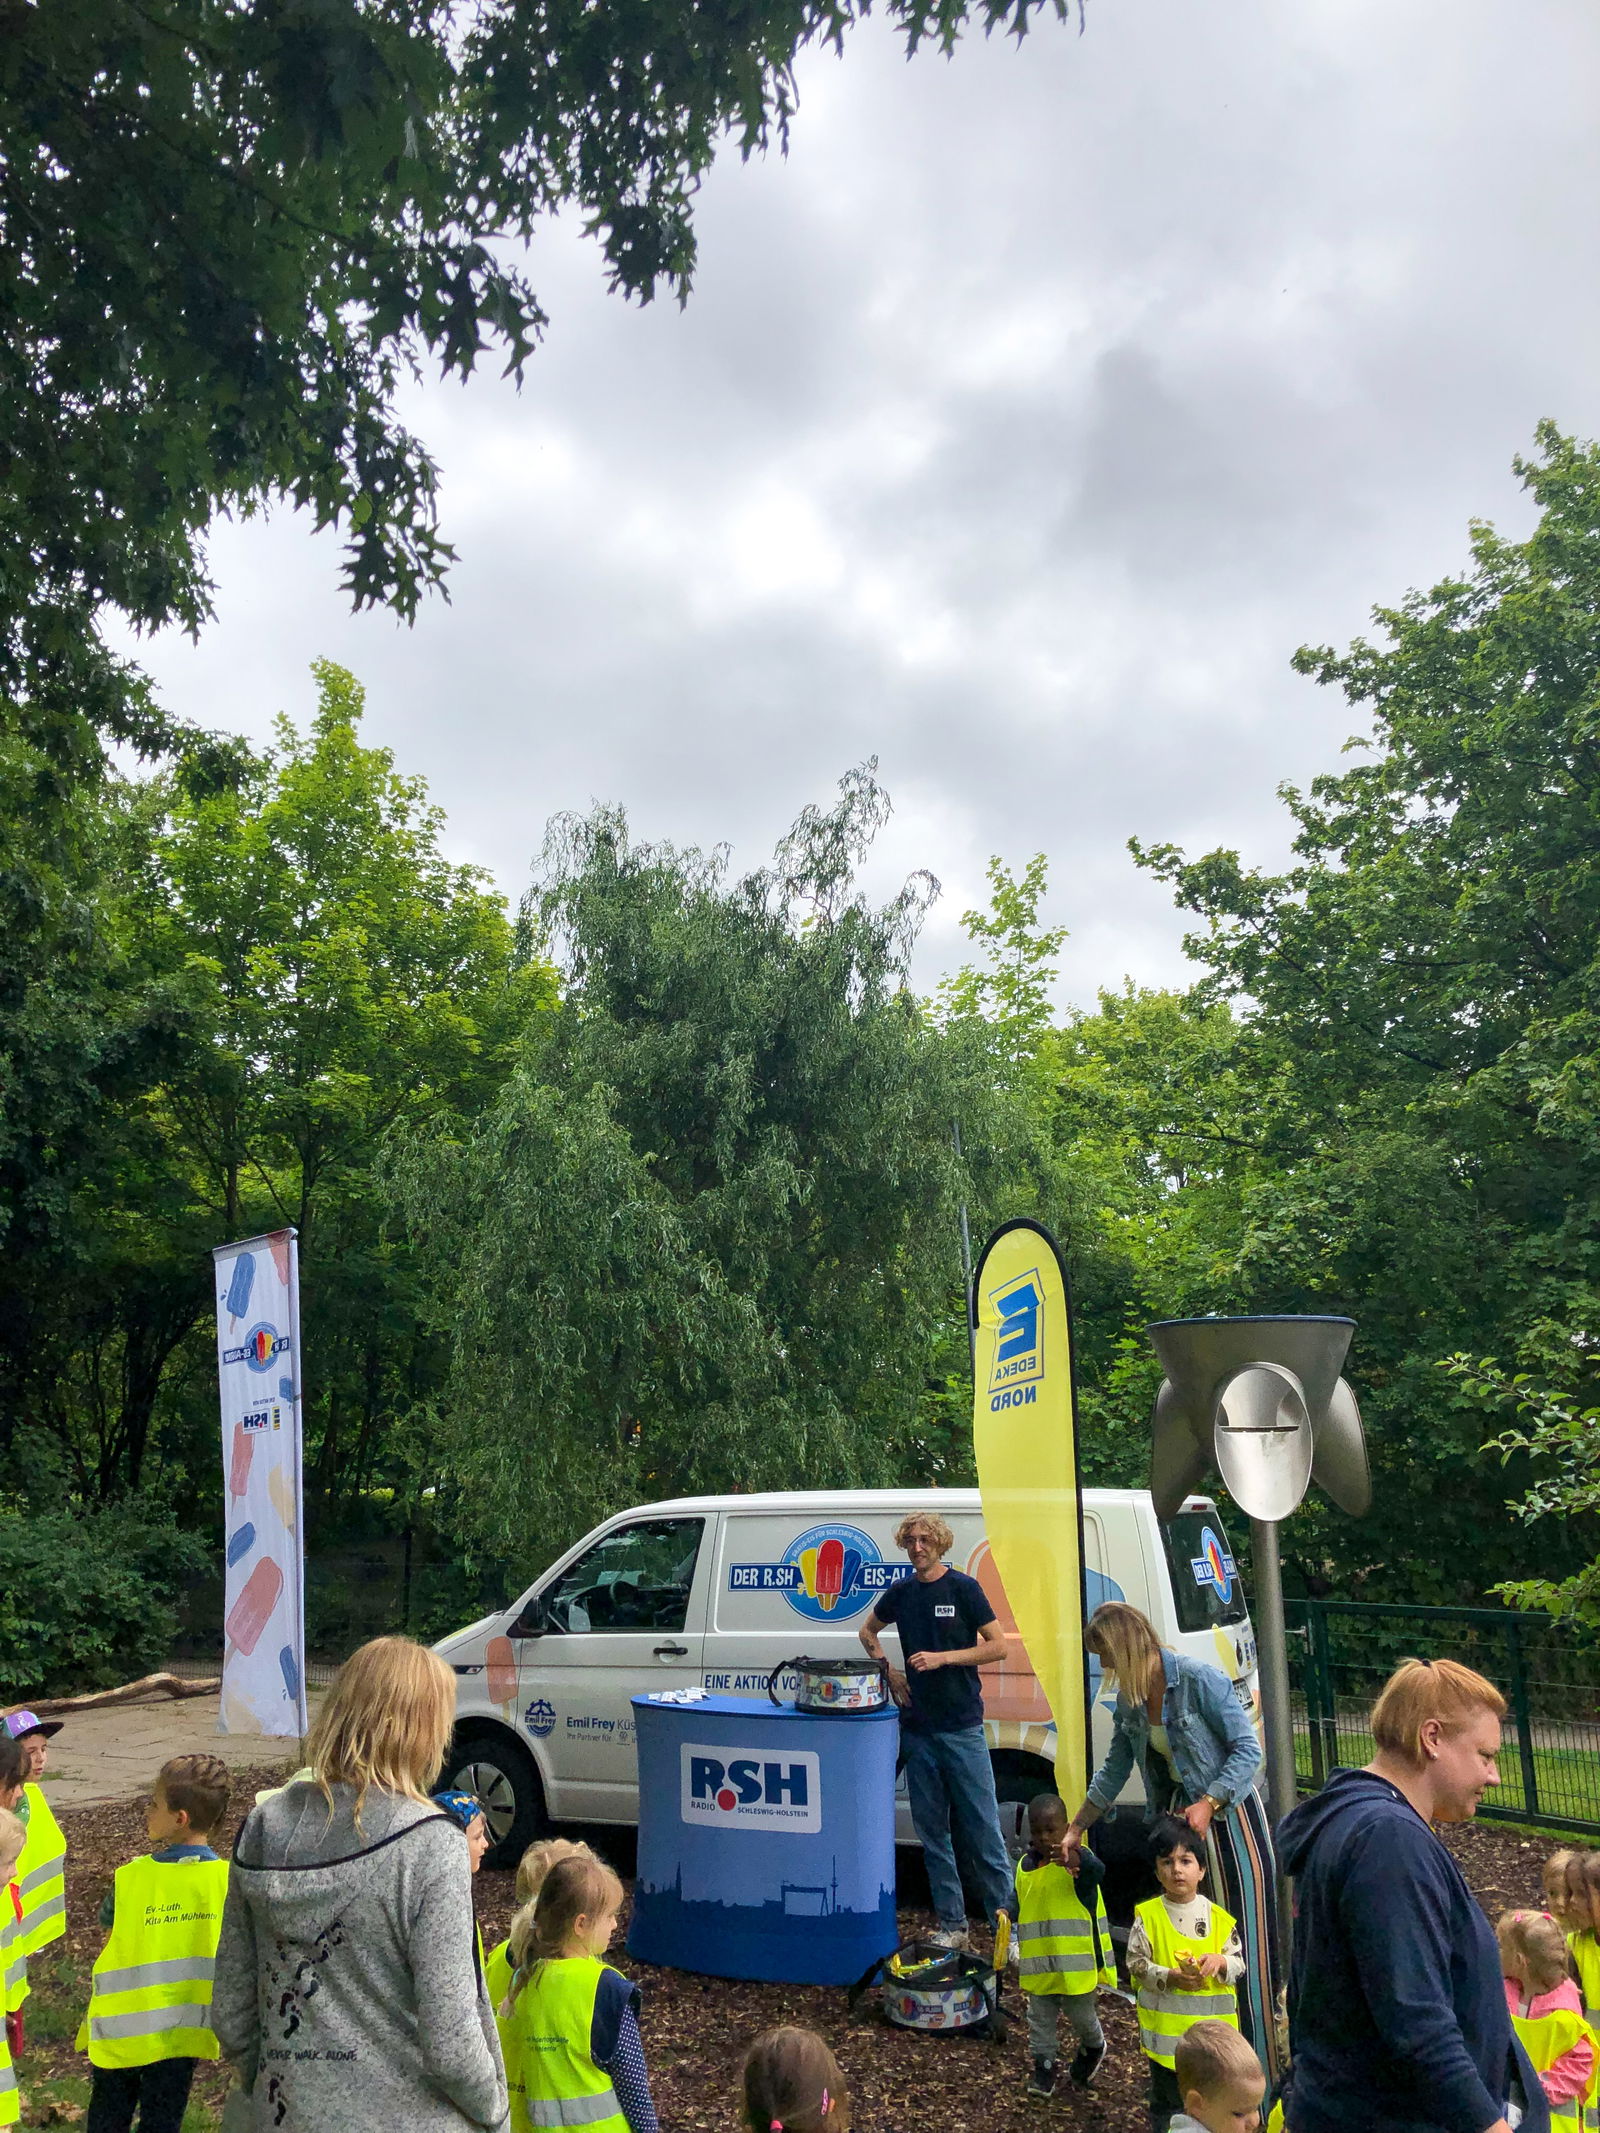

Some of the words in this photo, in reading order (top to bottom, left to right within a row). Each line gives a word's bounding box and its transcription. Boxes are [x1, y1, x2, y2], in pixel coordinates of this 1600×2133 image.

[733, 1568, 758, 1586] DER
[705, 1674, 732, 1689] EINE
[782, 1676, 798, 1691] VO
[524, 1716, 540, 1724] Emil
[566, 1717, 590, 1729] Emil
[592, 1718, 615, 1732] Frey
[617, 1718, 636, 1731] Küs
[690, 1801, 716, 1812] RADIO
[737, 1807, 809, 1818] SCHLESWIG-HOLSTEIN
[145, 1917, 162, 1926] Kita
[164, 1915, 178, 1923] Am
[295, 2049, 322, 2061] WALK
[325, 2049, 358, 2061] ALONE
